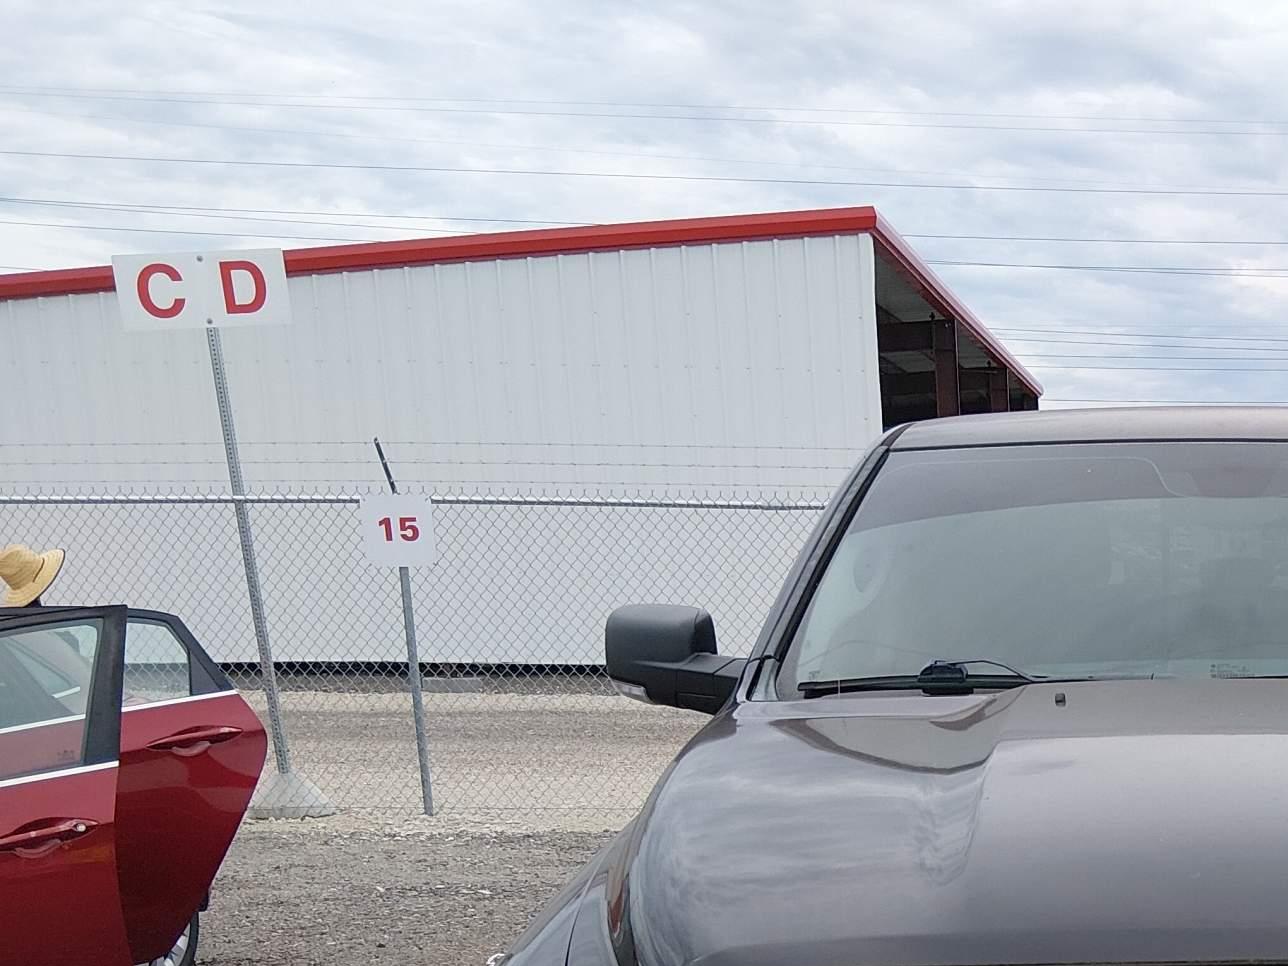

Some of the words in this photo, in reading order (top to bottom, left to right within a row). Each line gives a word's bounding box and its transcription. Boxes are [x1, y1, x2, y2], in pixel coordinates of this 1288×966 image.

[136, 262, 186, 319] C
[218, 260, 267, 315] D
[378, 516, 421, 542] 15
